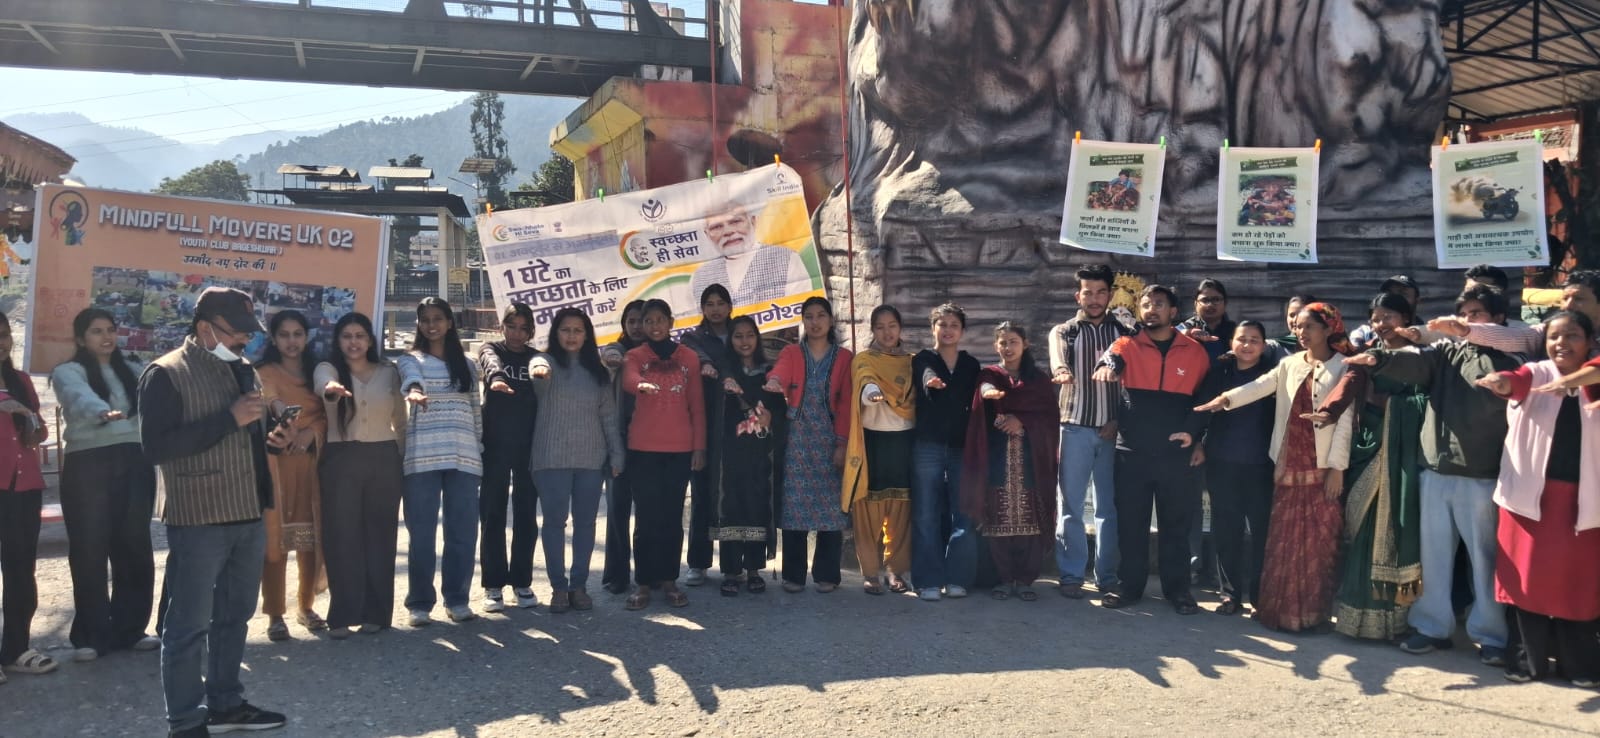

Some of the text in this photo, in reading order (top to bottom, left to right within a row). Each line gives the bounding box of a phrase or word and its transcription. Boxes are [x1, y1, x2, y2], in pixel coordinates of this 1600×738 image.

[98, 203, 353, 249] MINDFULL MOVERS UK 02
[648, 230, 698, 249] स्वच्छता
[656, 245, 699, 263] ही सेवा
[252, 258, 266, 271] की
[504, 258, 571, 288] 1 घंटे का
[507, 276, 628, 307] स्वच्छता के लिए
[595, 297, 617, 314] करें
